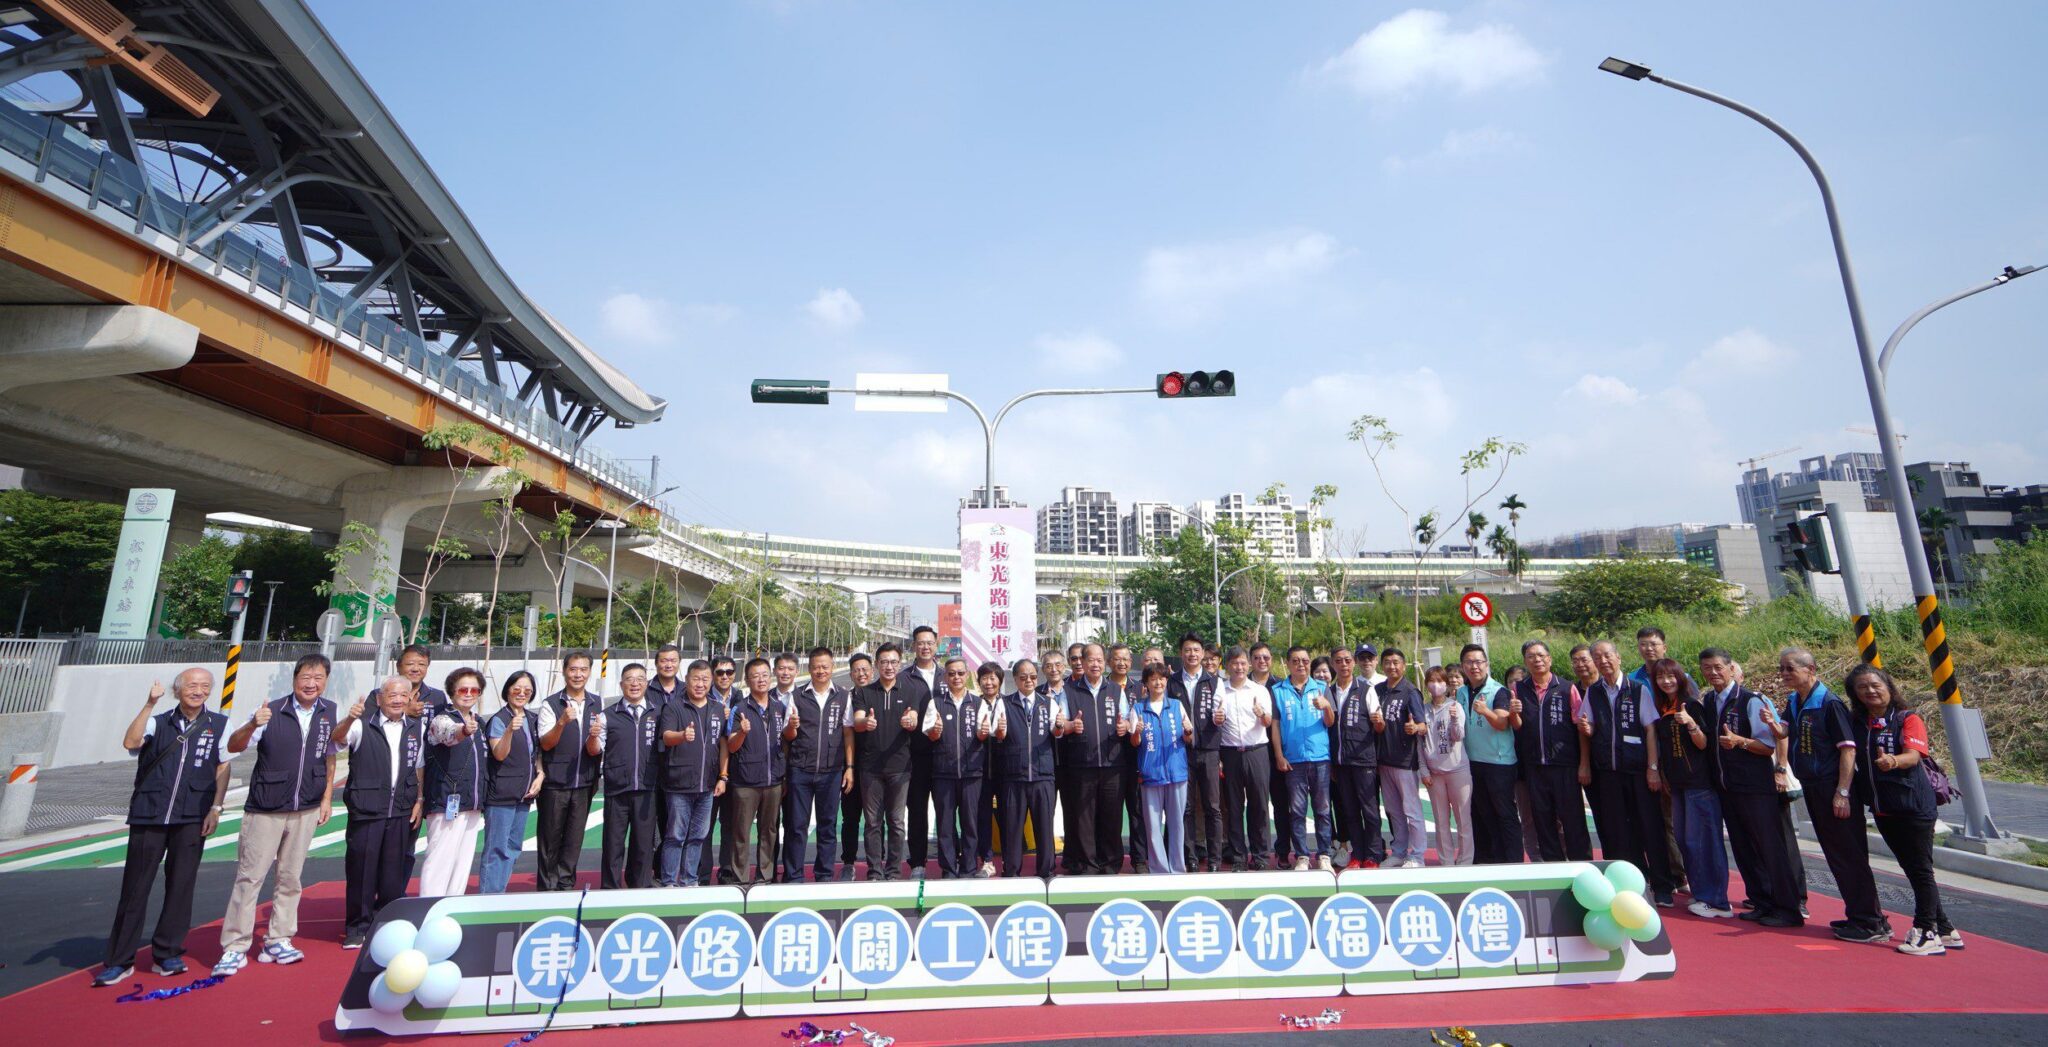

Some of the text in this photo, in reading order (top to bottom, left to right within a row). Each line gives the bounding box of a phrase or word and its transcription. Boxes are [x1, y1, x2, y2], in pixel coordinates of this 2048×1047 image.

[989, 541, 1010, 655] 東光路通車
[527, 902, 1512, 988] 東光路開闢工程 通車祈福典禮
